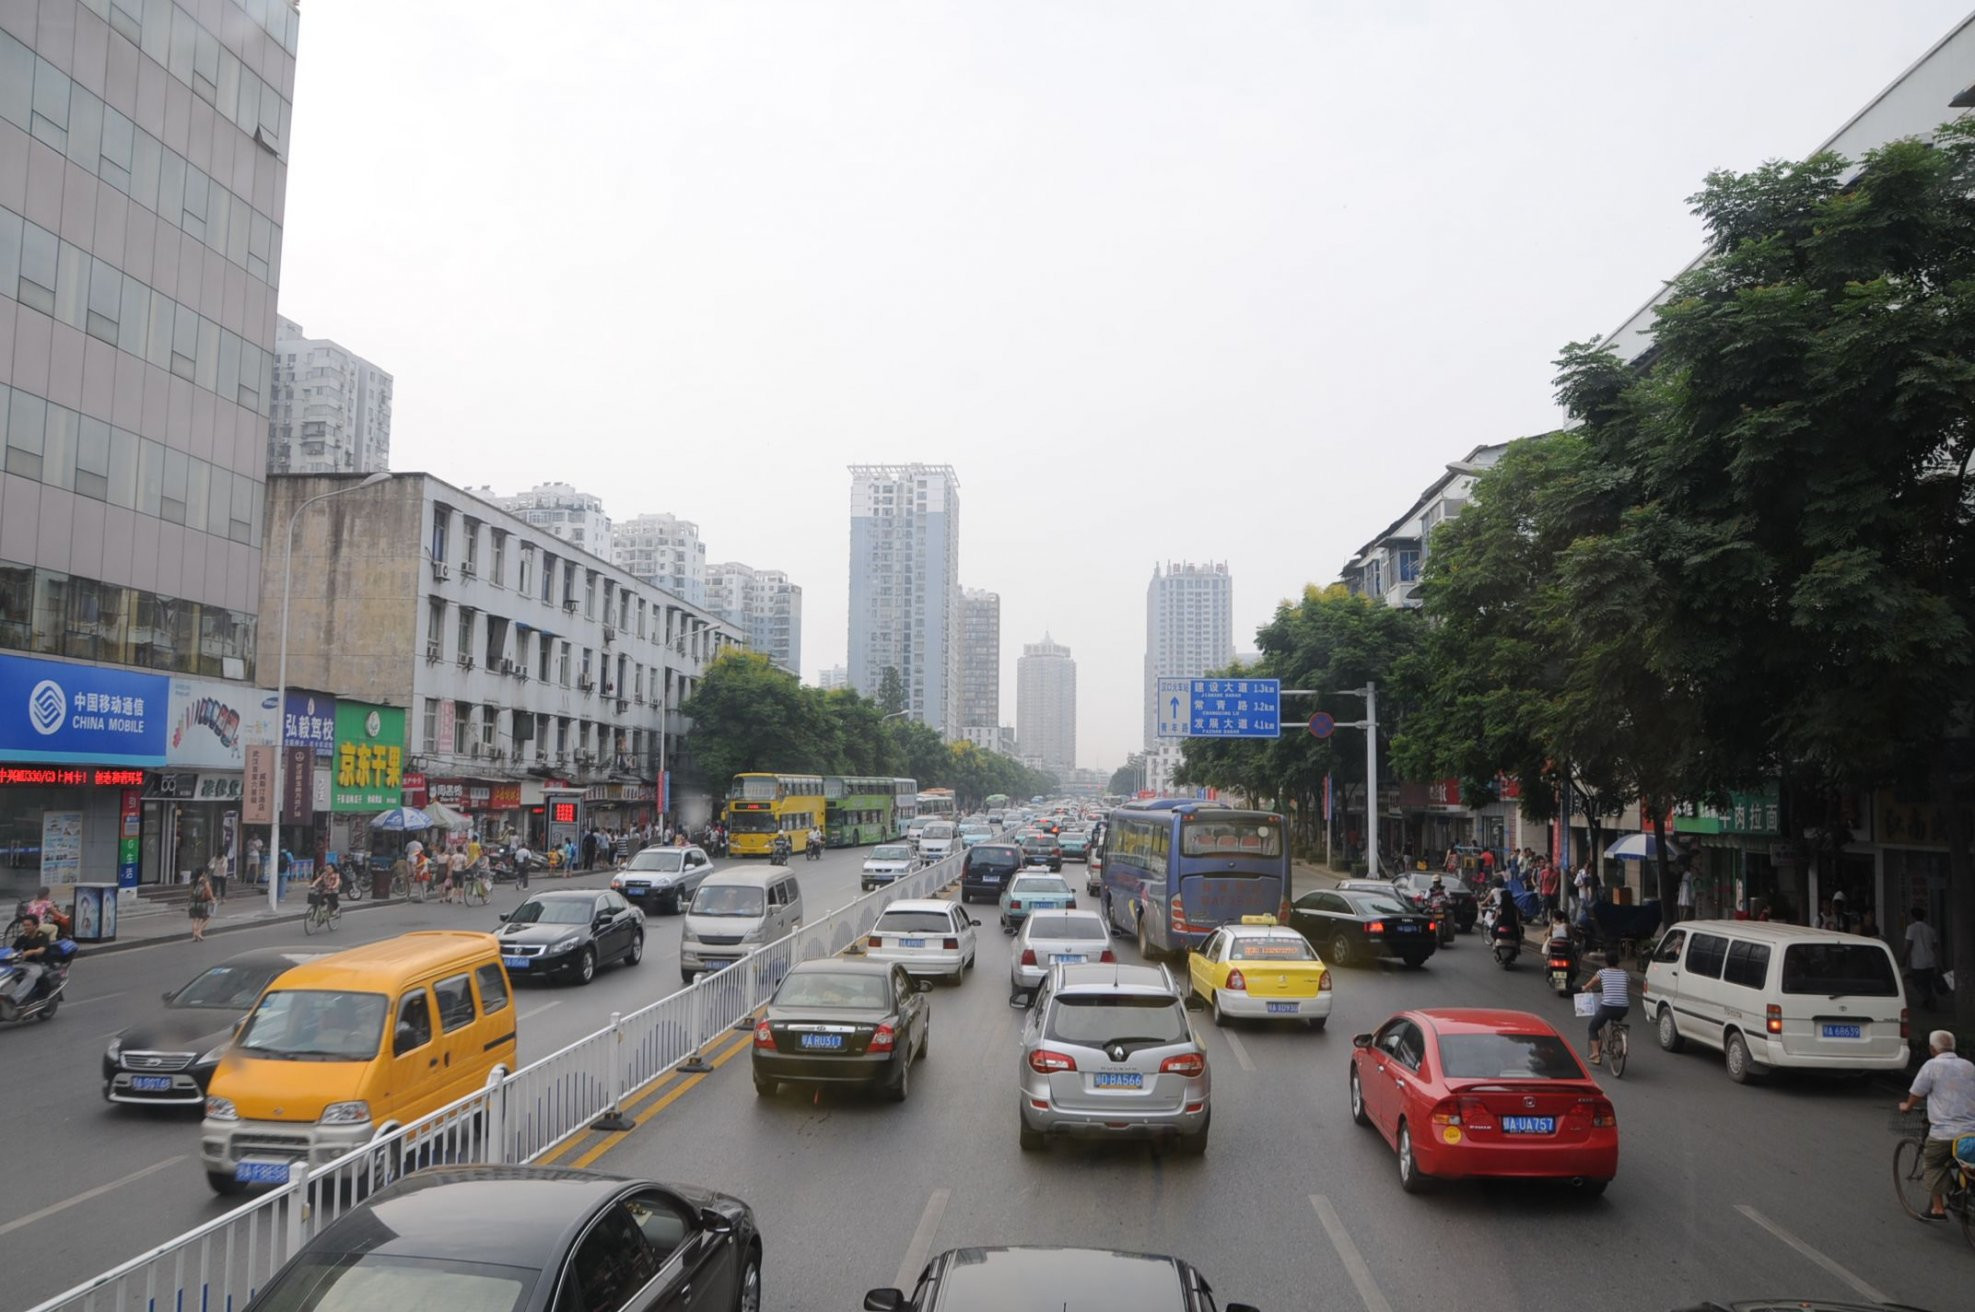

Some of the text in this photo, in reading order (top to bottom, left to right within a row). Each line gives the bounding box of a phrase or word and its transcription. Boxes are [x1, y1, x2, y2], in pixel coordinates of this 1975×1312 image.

[1194, 681, 1275, 693] 建设大道 1.3km
[74, 691, 145, 717] 中国移动通信
[1194, 699, 1275, 712] 常青路 3.2km
[72, 715, 145, 734] CHINA MOBILE
[285, 713, 334, 741] 弘毅驾校
[1194, 717, 1275, 730] 发展大道 4.1km
[338, 741, 401, 788] 京东干果
[1718, 801, 1778, 832] 牛肉拉面
